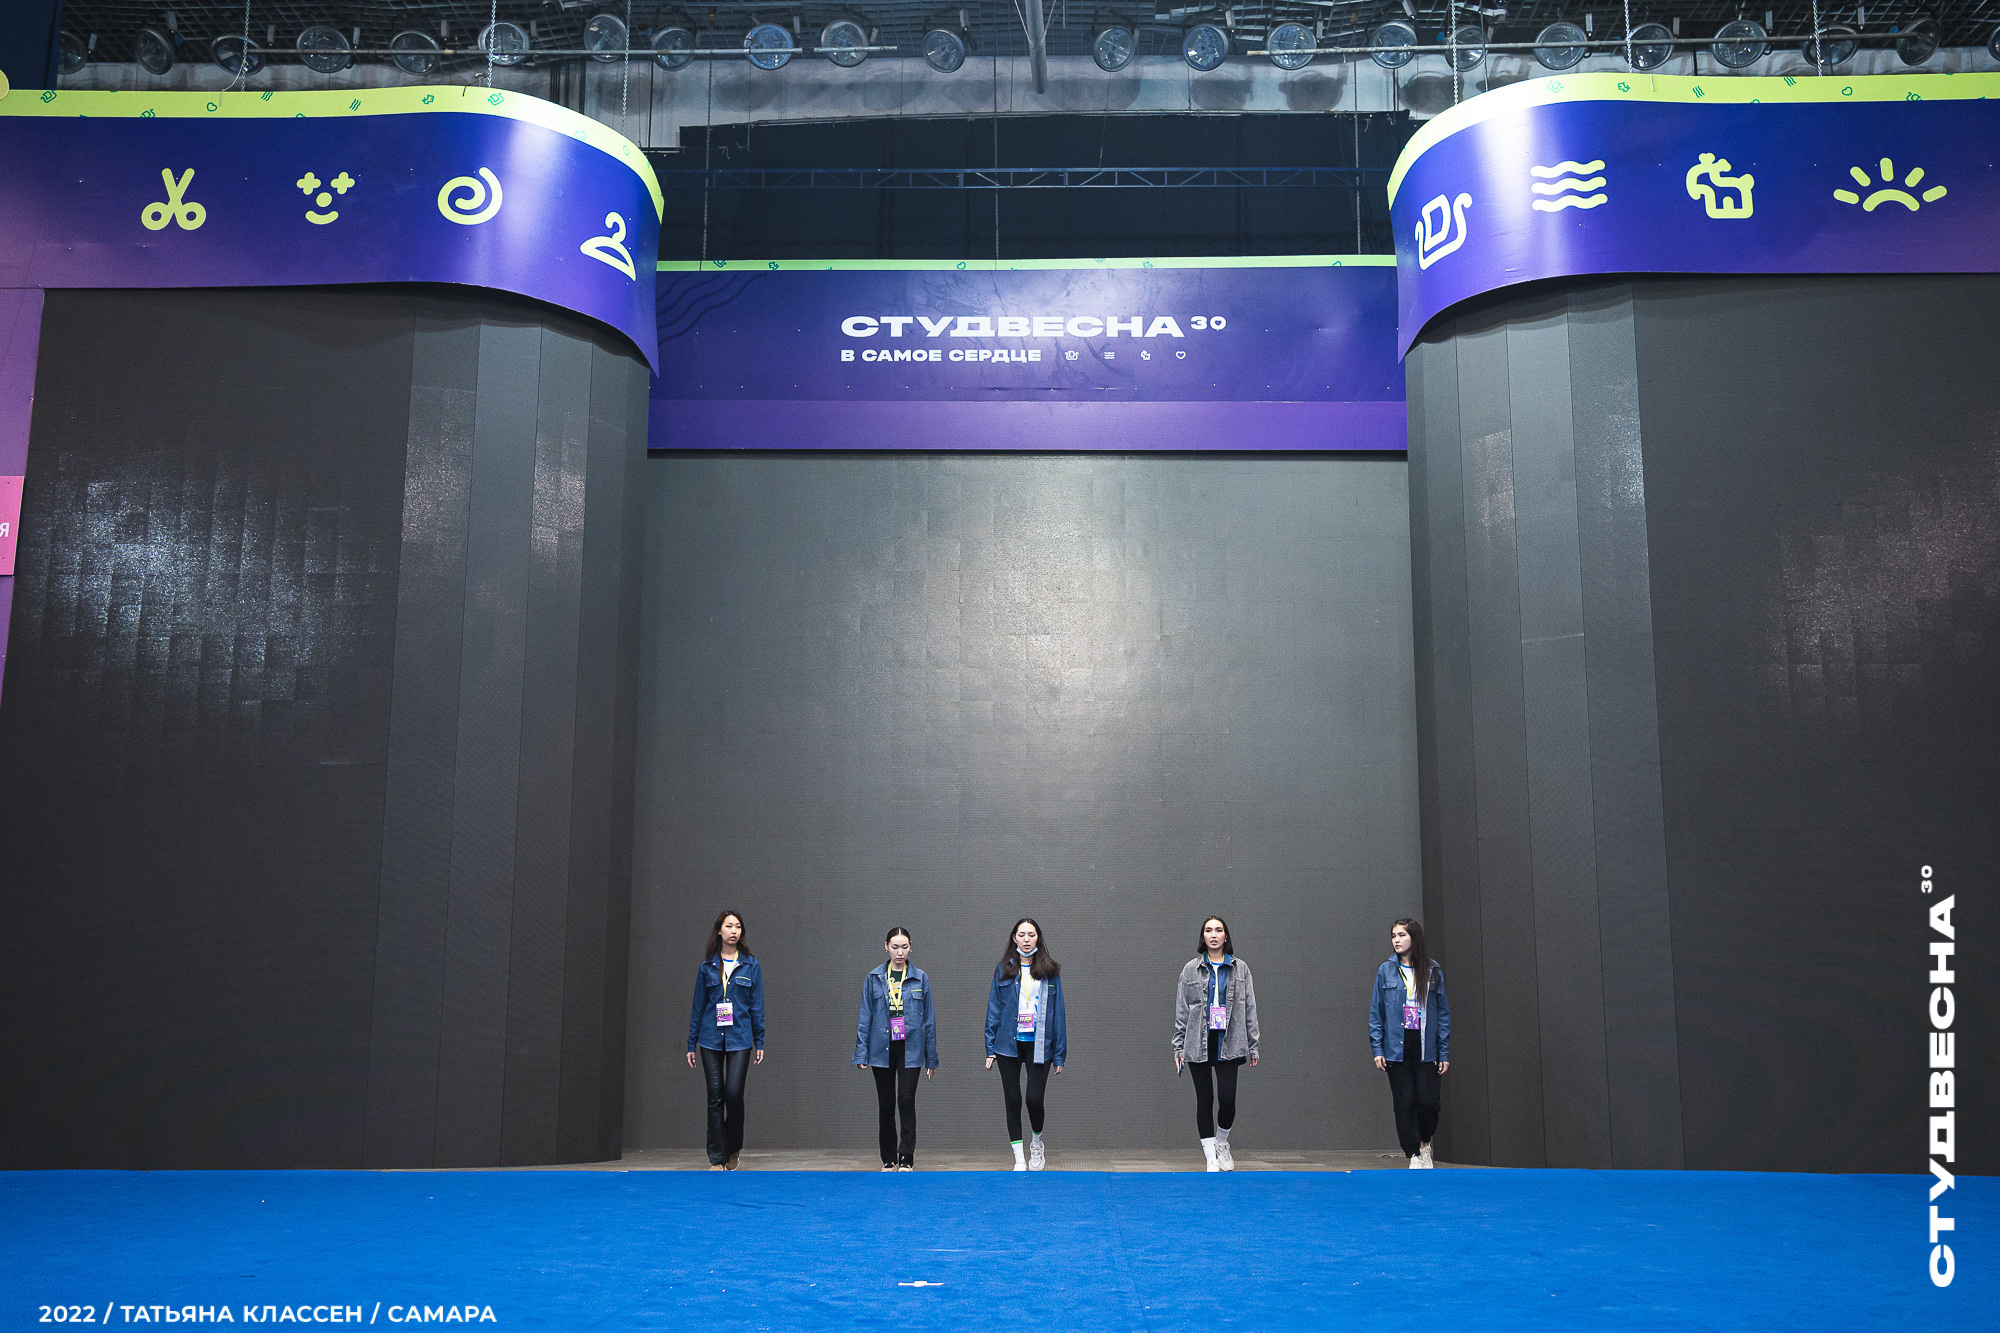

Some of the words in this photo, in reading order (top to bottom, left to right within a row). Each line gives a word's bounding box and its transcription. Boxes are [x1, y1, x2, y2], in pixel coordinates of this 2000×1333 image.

[841, 316, 1185, 338] СТУДВЕСНА
[841, 350, 855, 362] В
[861, 349, 942, 362] САМОЕ
[948, 349, 1042, 363] СЕРДЦЕ
